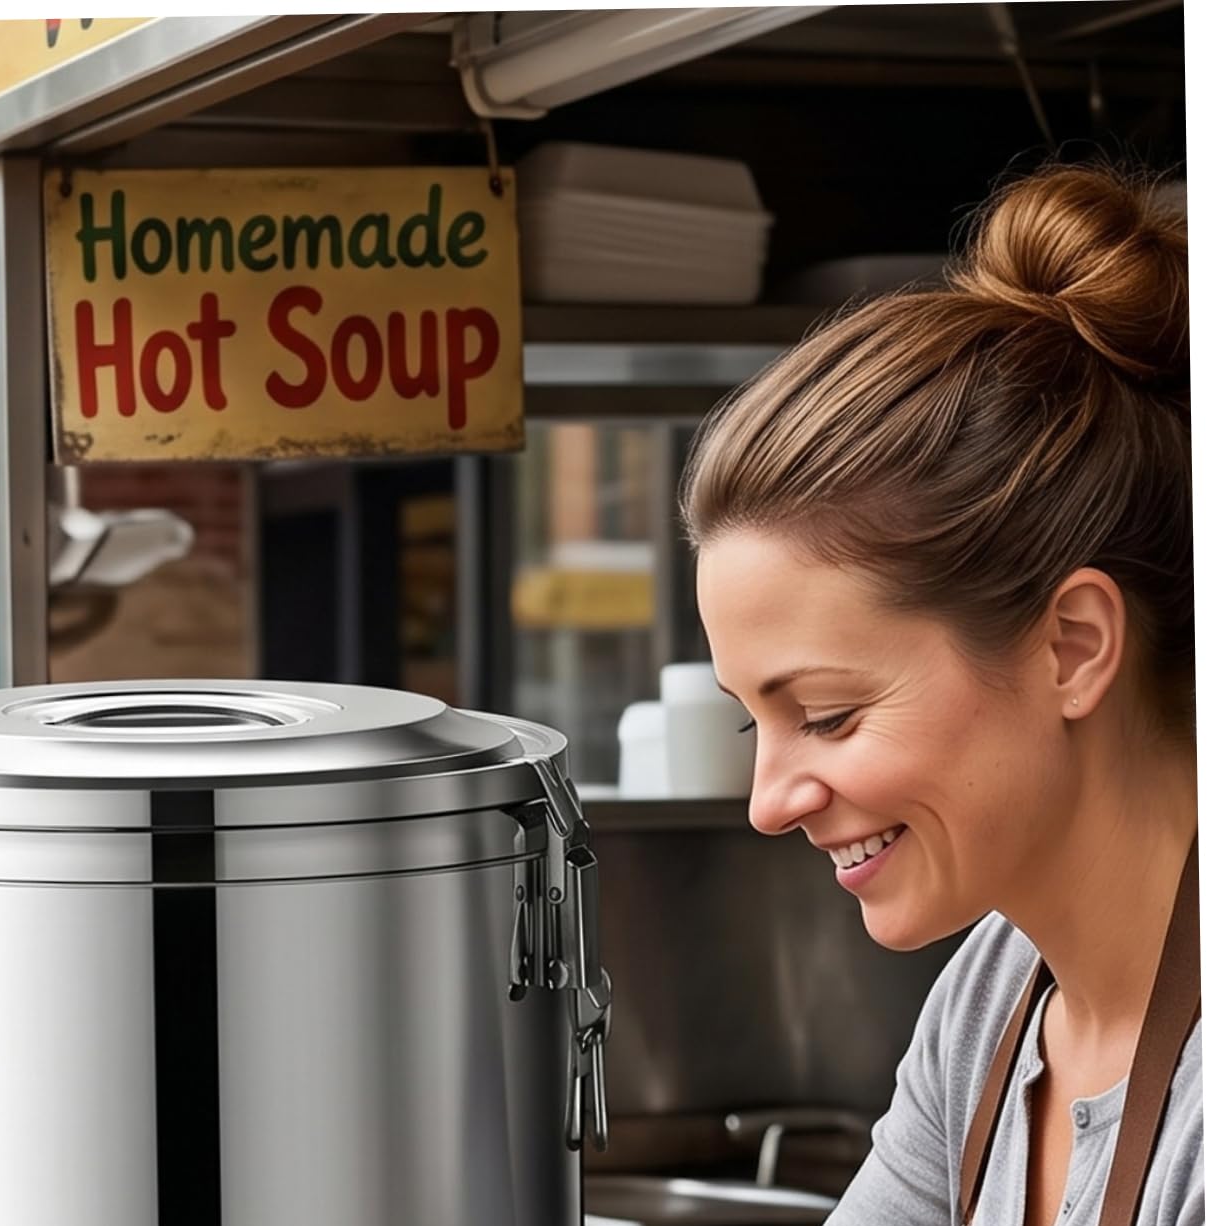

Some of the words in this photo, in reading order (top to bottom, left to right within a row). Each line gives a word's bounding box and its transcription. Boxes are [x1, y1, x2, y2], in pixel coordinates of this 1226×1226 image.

[77, 183, 489, 283] Homemade
[74, 291, 238, 419] Hot
[265, 285, 500, 431] Soup
